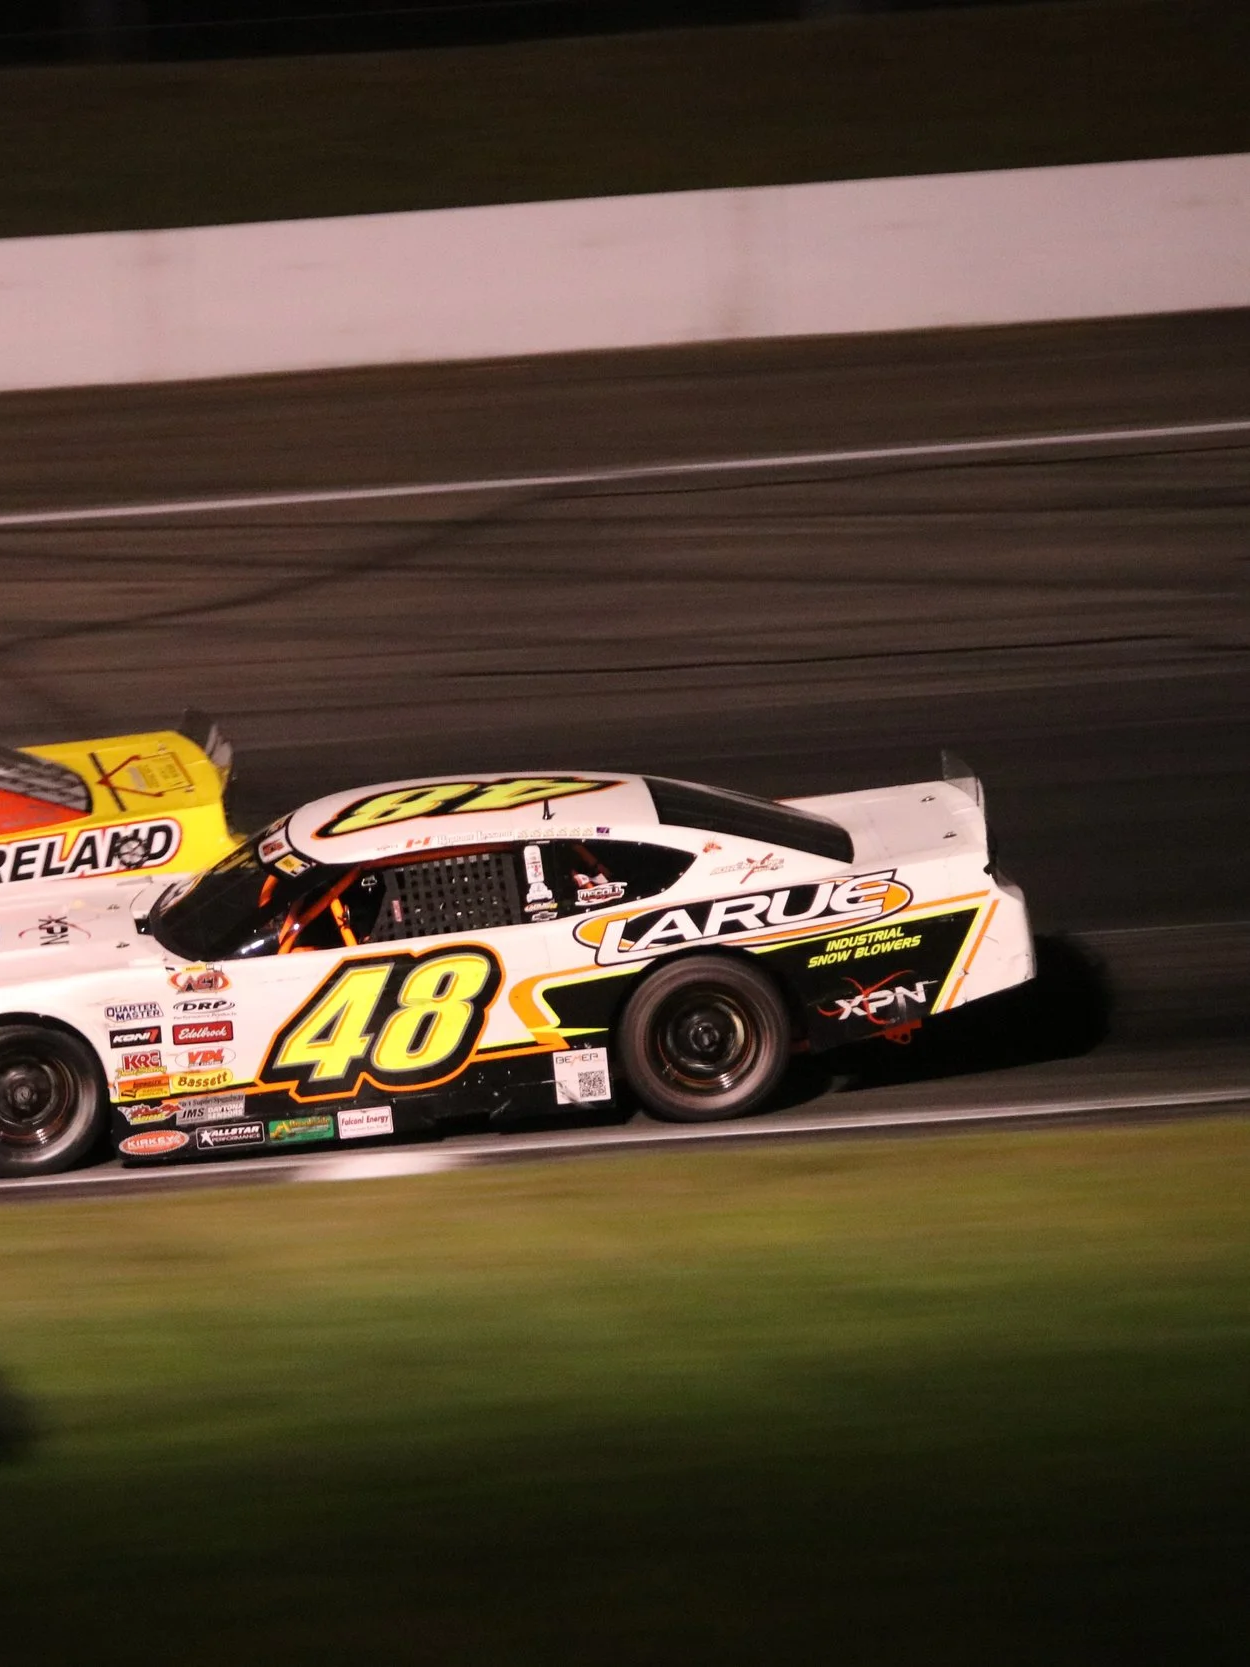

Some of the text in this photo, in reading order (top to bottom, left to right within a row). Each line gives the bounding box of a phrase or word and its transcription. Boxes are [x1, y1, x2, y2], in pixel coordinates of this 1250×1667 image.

[597, 869, 898, 966] LARUE
[825, 926, 905, 952] INDUSTRIAL
[807, 935, 922, 968] SNOW BLOWERS
[181, 1000, 228, 1012] DRP
[834, 979, 939, 1021] XPN
[105, 1003, 158, 1018] QUARTER
[115, 1009, 161, 1022] MASTER
[273, 952, 491, 1083] 48
[112, 1031, 151, 1044] KONI
[178, 1025, 228, 1041] Edelbrock
[123, 1052, 161, 1071] KRC
[177, 1072, 228, 1088] Bassett
[207, 1103, 245, 1113] DAYTONA
[366, 1114, 390, 1124] Energy
[210, 1125, 261, 1137] ALLSTAR
[211, 1133, 261, 1143] PERFORMANCE
[126, 1136, 177, 1151] KIRKEY
